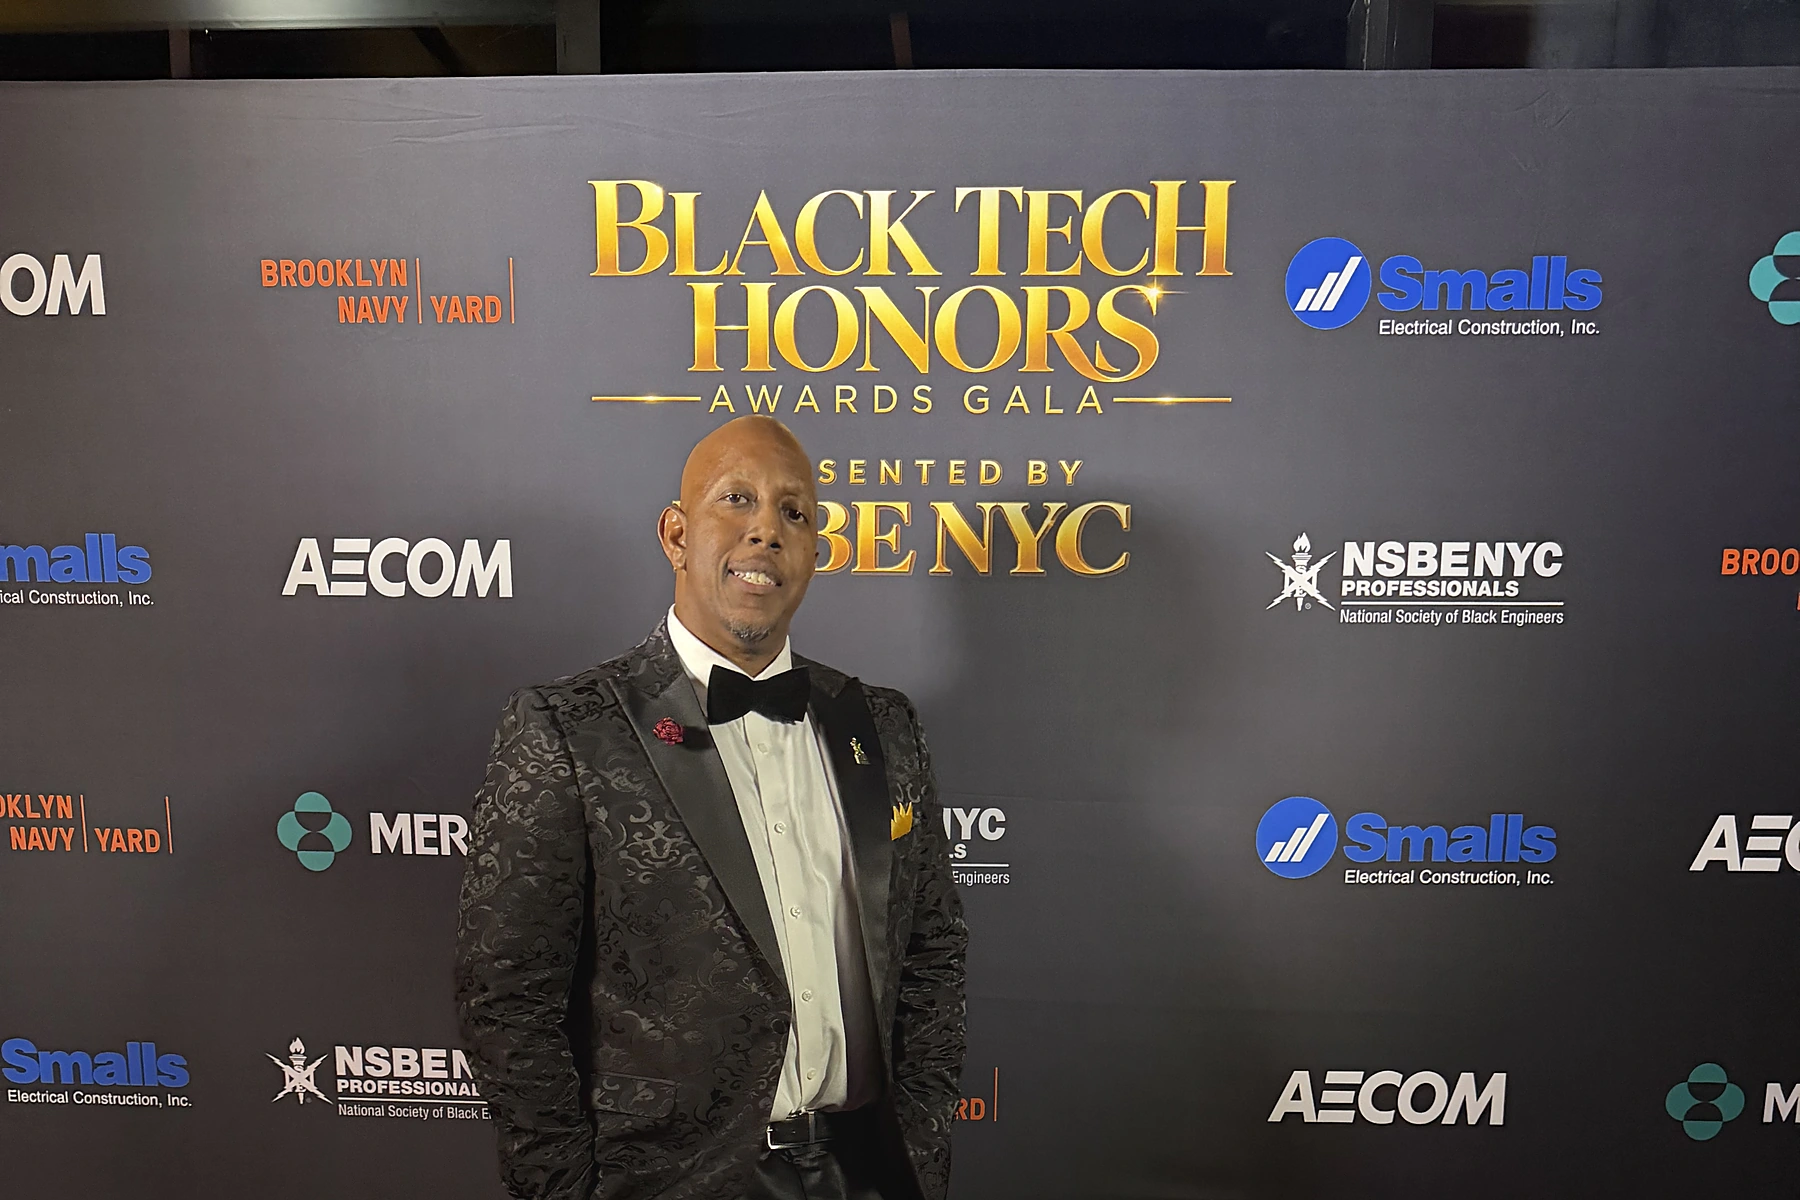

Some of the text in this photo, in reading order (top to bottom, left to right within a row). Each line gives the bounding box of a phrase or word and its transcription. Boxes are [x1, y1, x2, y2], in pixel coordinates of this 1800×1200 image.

[588, 180, 1236, 276] BLACK TECH
[261, 259, 407, 287] BROOKLYN
[1377, 255, 1603, 311] Smalls
[338, 296, 502, 323] NAVY YARD
[687, 283, 1160, 383] HONORS
[1379, 319, 1600, 337] Electrical Construction, Inc.
[710, 385, 1103, 414] AWARDS GALA
[1027, 459, 1083, 485] BY
[928, 501, 1131, 575] NYC
[281, 538, 513, 598] AECOM
[29, 589, 124, 607] Construction,
[128, 590, 154, 605] Inc.
[1341, 580, 1519, 597] PROFESSIONALS
[1340, 609, 1564, 626] National Society of Black Engineers
[10, 826, 161, 853] NAVY YARD
[370, 812, 472, 857] MER
[1343, 812, 1557, 864] Smalls
[1344, 869, 1554, 887] Electrical Construction, Inc.
[1, 1038, 190, 1088] Smalls
[8, 1089, 192, 1107] Electrical Construction, Inc.
[1267, 1070, 1507, 1125] AECOM
[338, 1104, 385, 1117] National
[388, 1105, 429, 1120] Society
[432, 1105, 444, 1119] of
[447, 1106, 478, 1120] Black
